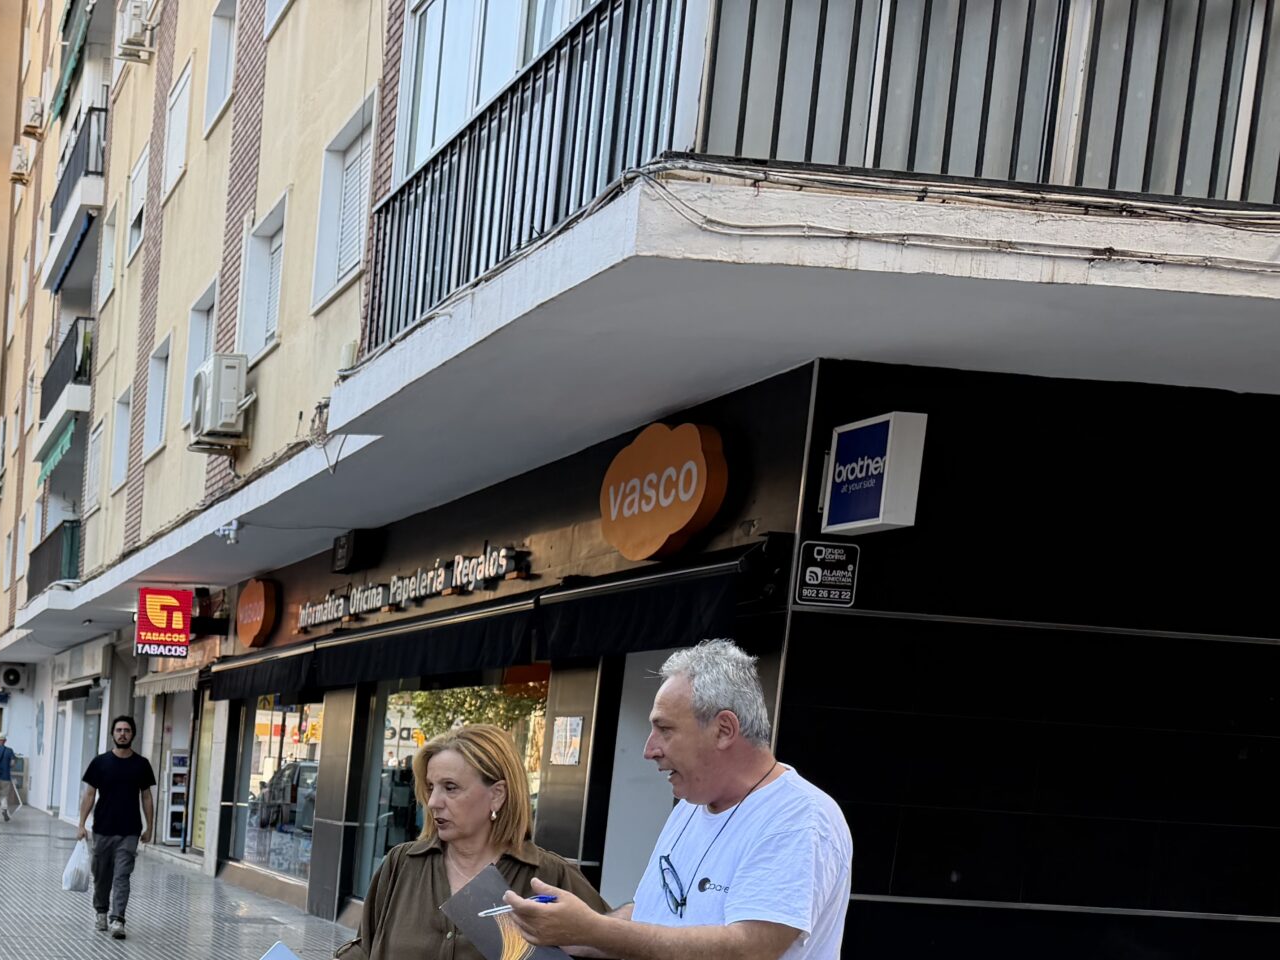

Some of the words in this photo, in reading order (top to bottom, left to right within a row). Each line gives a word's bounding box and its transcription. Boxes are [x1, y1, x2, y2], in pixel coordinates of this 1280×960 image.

[835, 455, 886, 483] brother
[609, 460, 698, 521] vasco
[822, 569, 853, 578] ALARMA
[298, 593, 345, 629] Informática
[349, 582, 383, 614] Oficina
[389, 558, 445, 607] Papelería
[452, 546, 508, 591] Regalos
[802, 588, 817, 597] 902
[818, 590, 828, 598] 26
[829, 591, 840, 599] 22
[840, 591, 851, 599] 22
[139, 631, 187, 642] TABACOS
[136, 643, 188, 657] TABACOS
